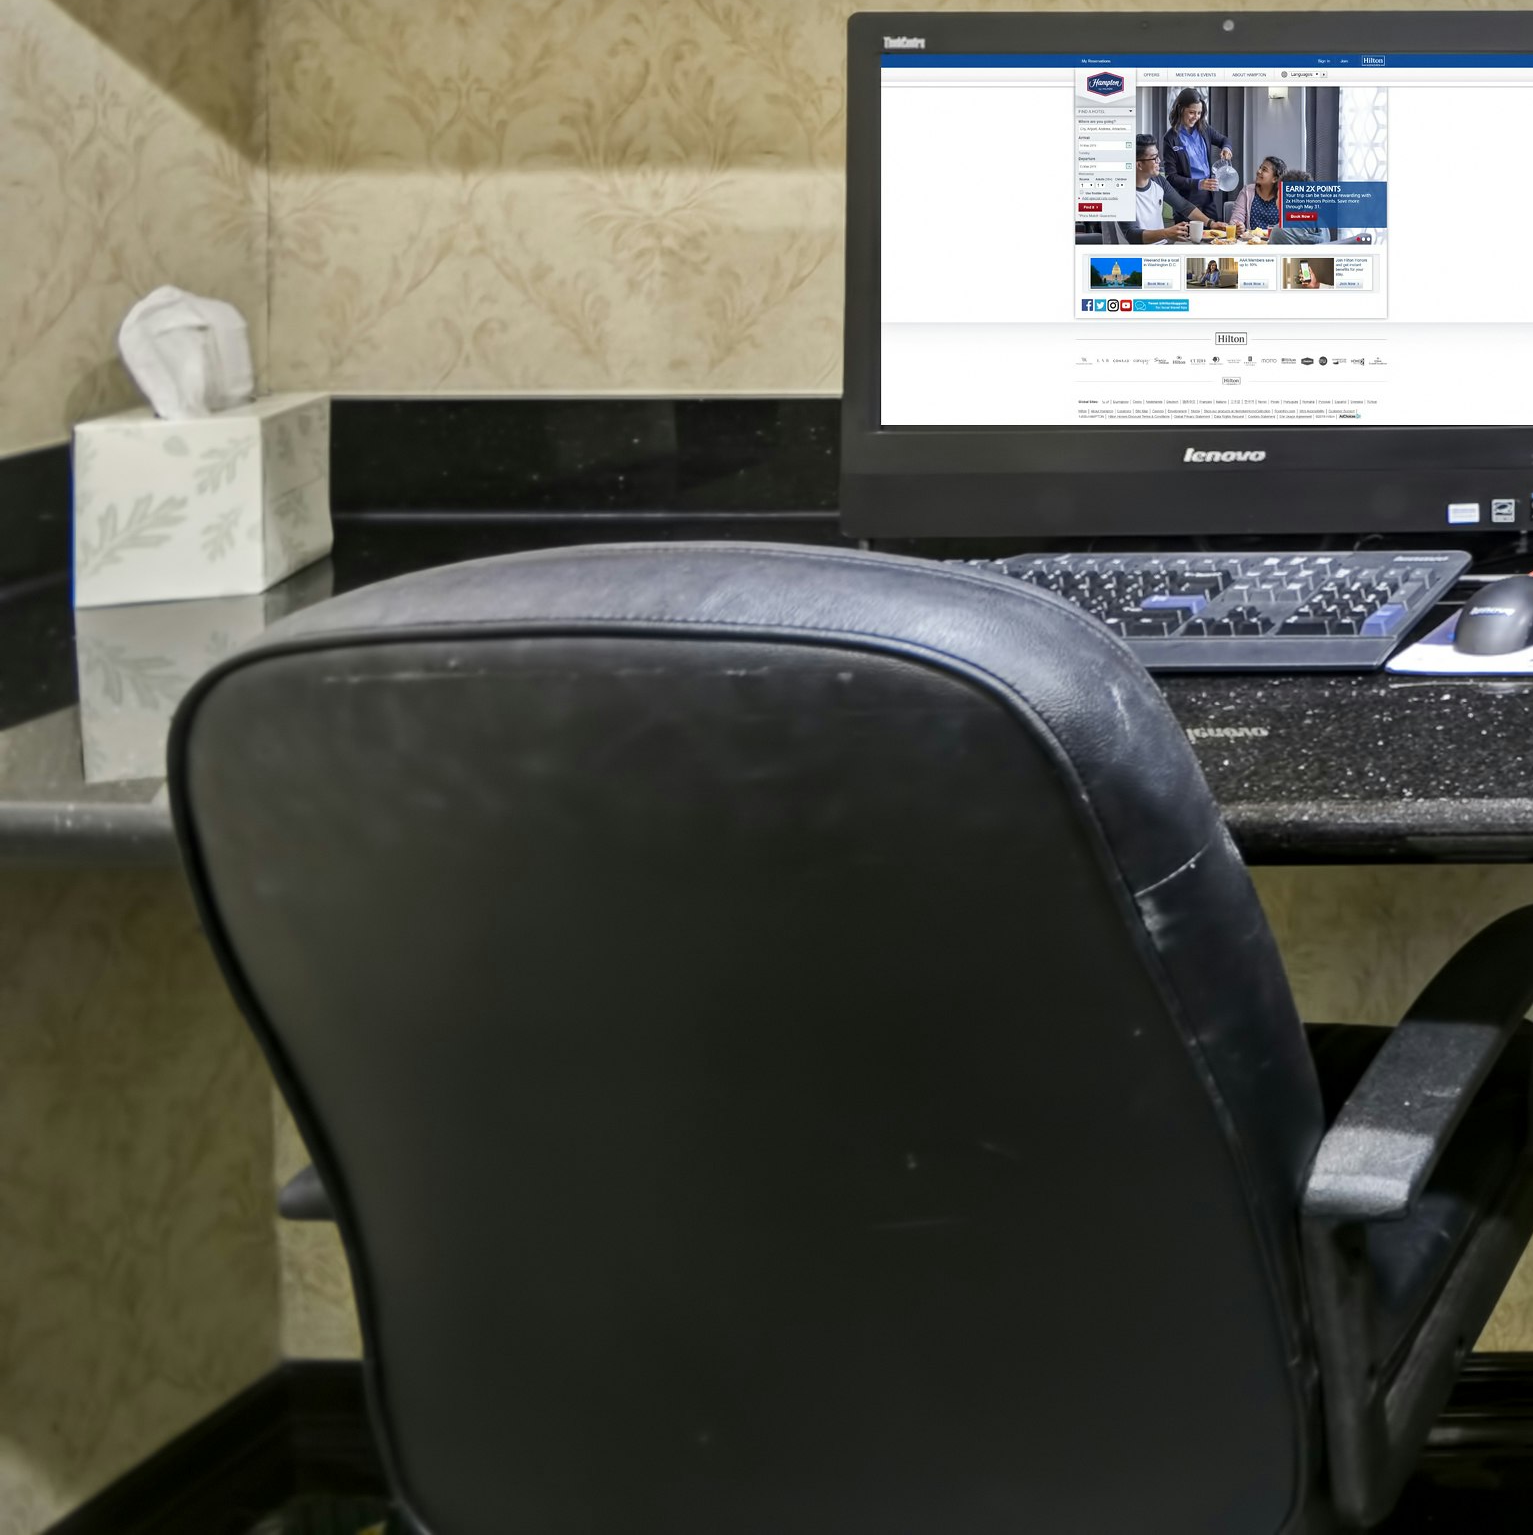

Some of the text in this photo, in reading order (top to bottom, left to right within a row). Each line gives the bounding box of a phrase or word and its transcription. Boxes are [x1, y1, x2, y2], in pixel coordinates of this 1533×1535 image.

[1089, 78, 1122, 88] Hampton
[1285, 185, 1341, 193] EARN 2X POINTS
[1217, 334, 1245, 343] Hilton
[1183, 447, 1267, 463] lenovo
